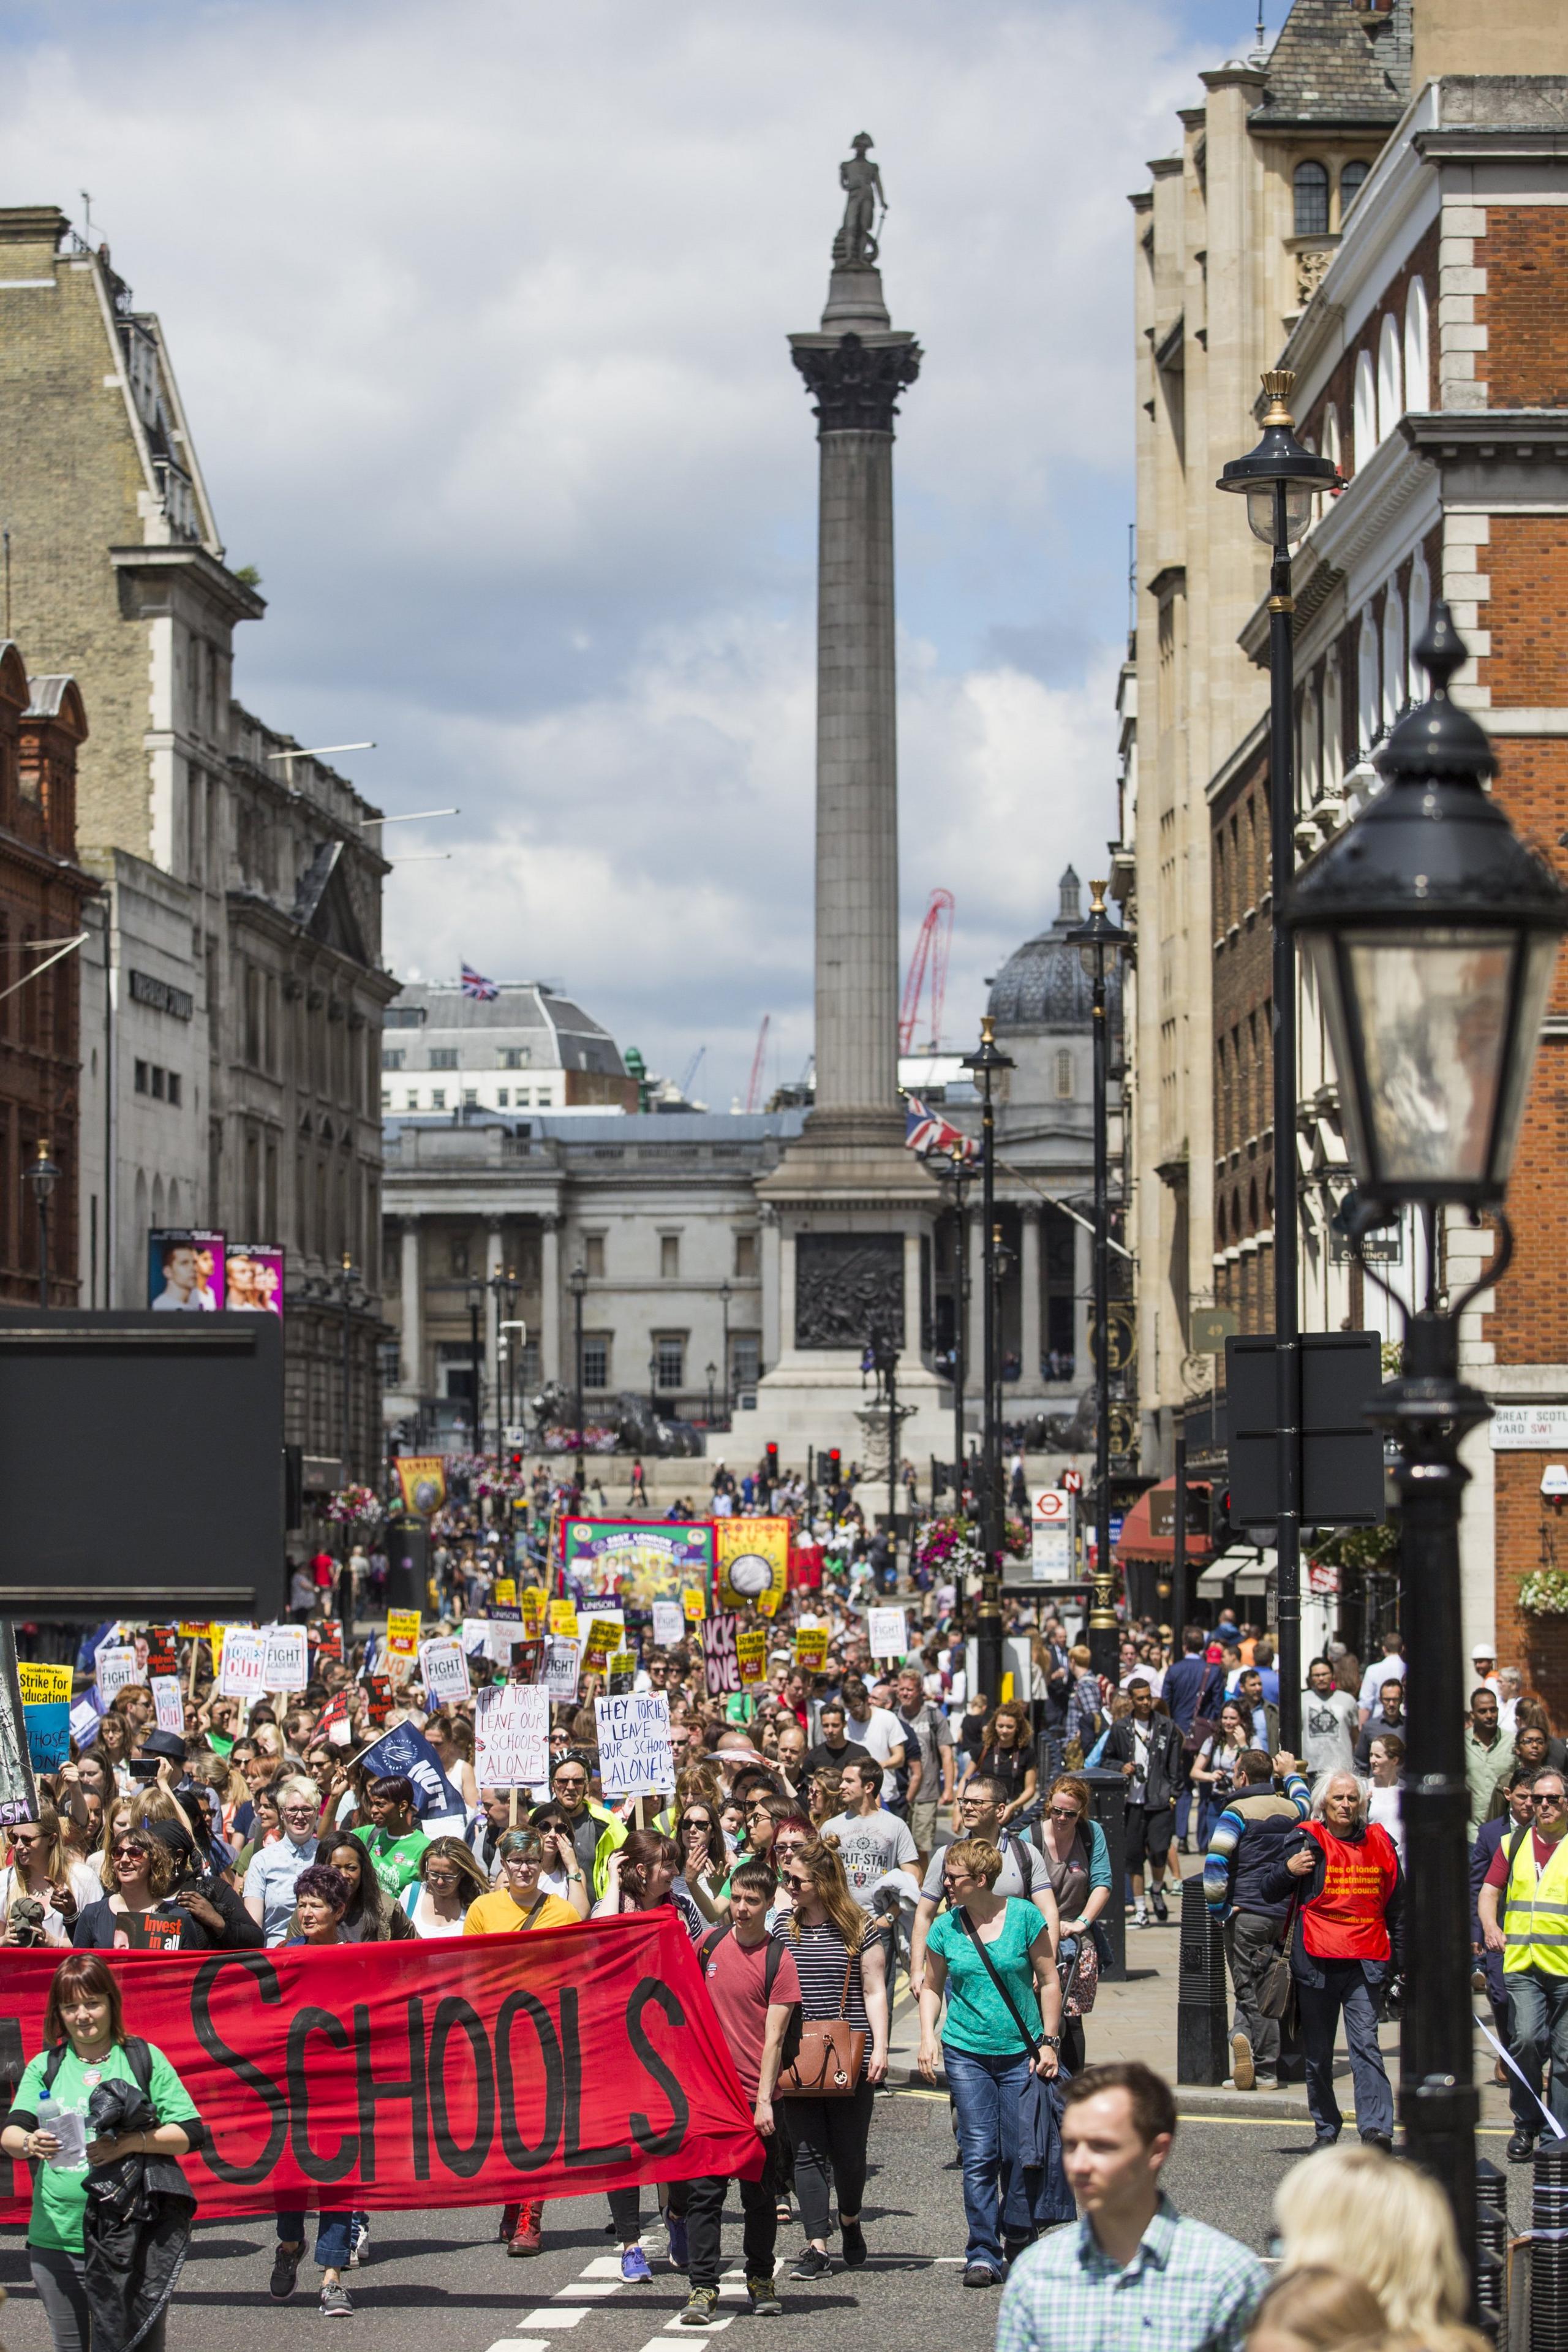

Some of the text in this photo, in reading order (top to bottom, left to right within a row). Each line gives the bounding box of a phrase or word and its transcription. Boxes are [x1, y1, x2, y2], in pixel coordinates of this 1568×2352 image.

[1496, 1411, 1528, 1421] GREAT
[1497, 1424, 1551, 1434] YARD SW1
[1065, 1472, 1080, 1489] N
[582, 1600, 616, 1611] UNISON
[491, 1611, 519, 1620] UNISON
[875, 1625, 899, 1635] FIGHT
[739, 1635, 755, 1645] Strike
[228, 1646, 263, 1659] TORIES
[268, 1649, 300, 1661] FIGHT
[739, 1646, 764, 1655] education
[226, 1658, 258, 1677] OUT!
[382, 1654, 405, 1676] NO
[429, 1658, 461, 1676] FIGHT
[546, 1659, 574, 1673] FIGHT
[20, 1673, 68, 1690] Strike for
[102, 1671, 131, 1684] FIGHT
[429, 1671, 462, 1682] ACADEMIES
[21, 1690, 68, 1703] education
[481, 1685, 546, 1714] HEY TORIES
[601, 1699, 667, 1722] HEY TORIES
[481, 1712, 548, 1732] LEAVE OUR
[612, 1720, 651, 1741] LEAVE
[27, 1730, 68, 1748] THOSE
[491, 1733, 541, 1752] SCHOOLS
[602, 1738, 672, 1760] OUR SCHOOLS
[382, 1753, 402, 1771] TEACHERS
[484, 1754, 545, 1777] ALONE!
[612, 1754, 666, 1787] ALONE!
[407, 1760, 448, 1810] NUT
[1346, 1864, 1355, 1873] of
[1325, 1875, 1332, 1883] &
[144, 1915, 182, 1935] Invest
[149, 1931, 180, 1950] in all
[190, 1952, 690, 2186] SCHOOLS
